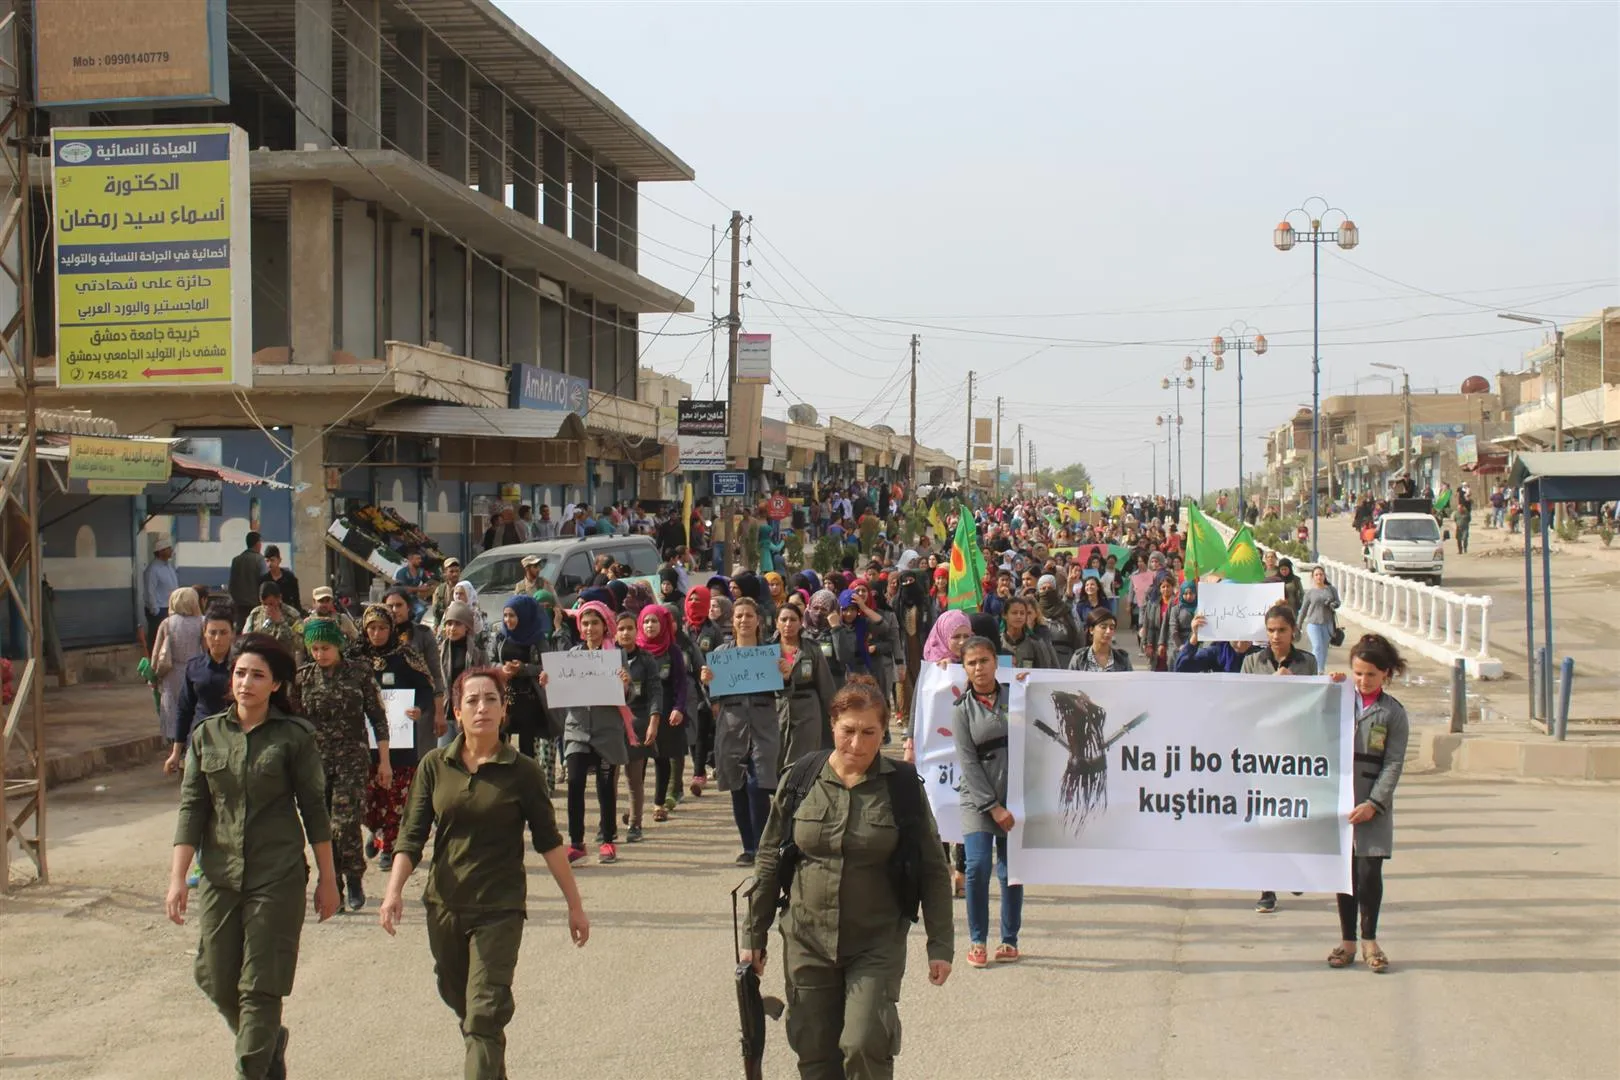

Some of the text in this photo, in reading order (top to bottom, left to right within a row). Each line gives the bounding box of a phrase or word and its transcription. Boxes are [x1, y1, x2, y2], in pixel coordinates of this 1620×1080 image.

[73, 56, 95, 67] Mob
[104, 52, 169, 66] 0990140779
[96, 141, 197, 161] العيادة النسائية
[104, 172, 180, 196] الدكتورة
[60, 198, 225, 232] أسماء سيد رمضان
[60, 245, 227, 267] أخصائية في الجراحة النسائية والتوليد
[75, 276, 212, 295] حائزة على شهادتي
[77, 298, 209, 320] الماجستير والبورد العربي
[89, 325, 200, 346] خريجة جامعة دمشق
[66, 345, 227, 365] مشفى دار التوليد الجامعي بدمشق
[87, 370, 128, 380] 745842
[1121, 745, 1329, 778] Na ji bo tawana
[1139, 787, 1309, 822] kuştina jinan
